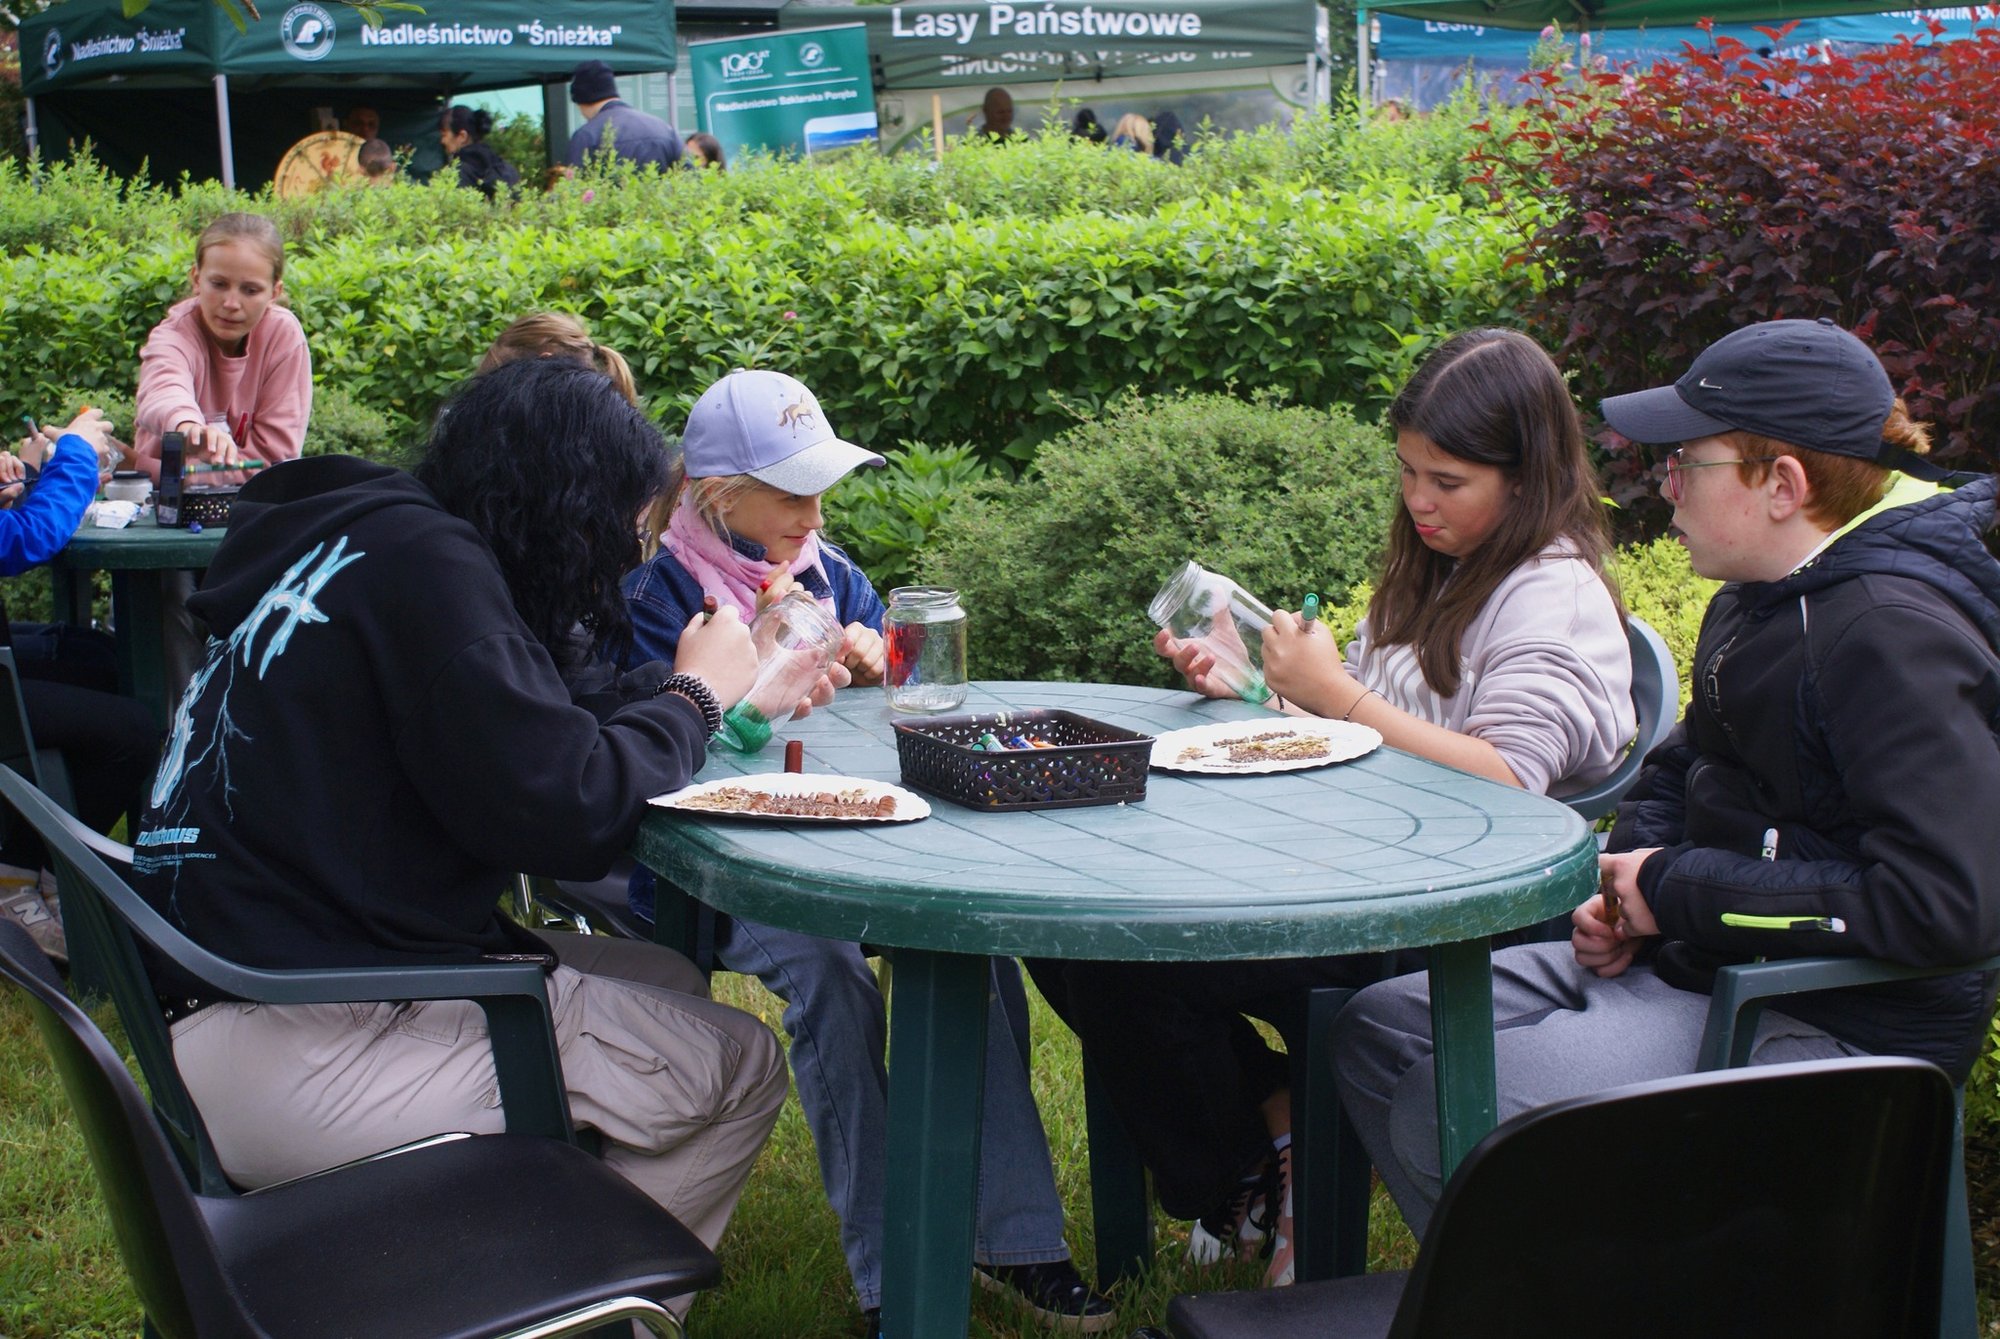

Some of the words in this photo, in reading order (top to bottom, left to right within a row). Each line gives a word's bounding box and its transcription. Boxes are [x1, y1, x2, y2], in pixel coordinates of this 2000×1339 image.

[361, 23, 514, 46] Nadleśnictwo
[518, 20, 622, 46] "Śnieżka"
[892, 8, 978, 44] Lasy
[989, 4, 1202, 37] Państwowe
[70, 34, 135, 61] Nadleśnictwo
